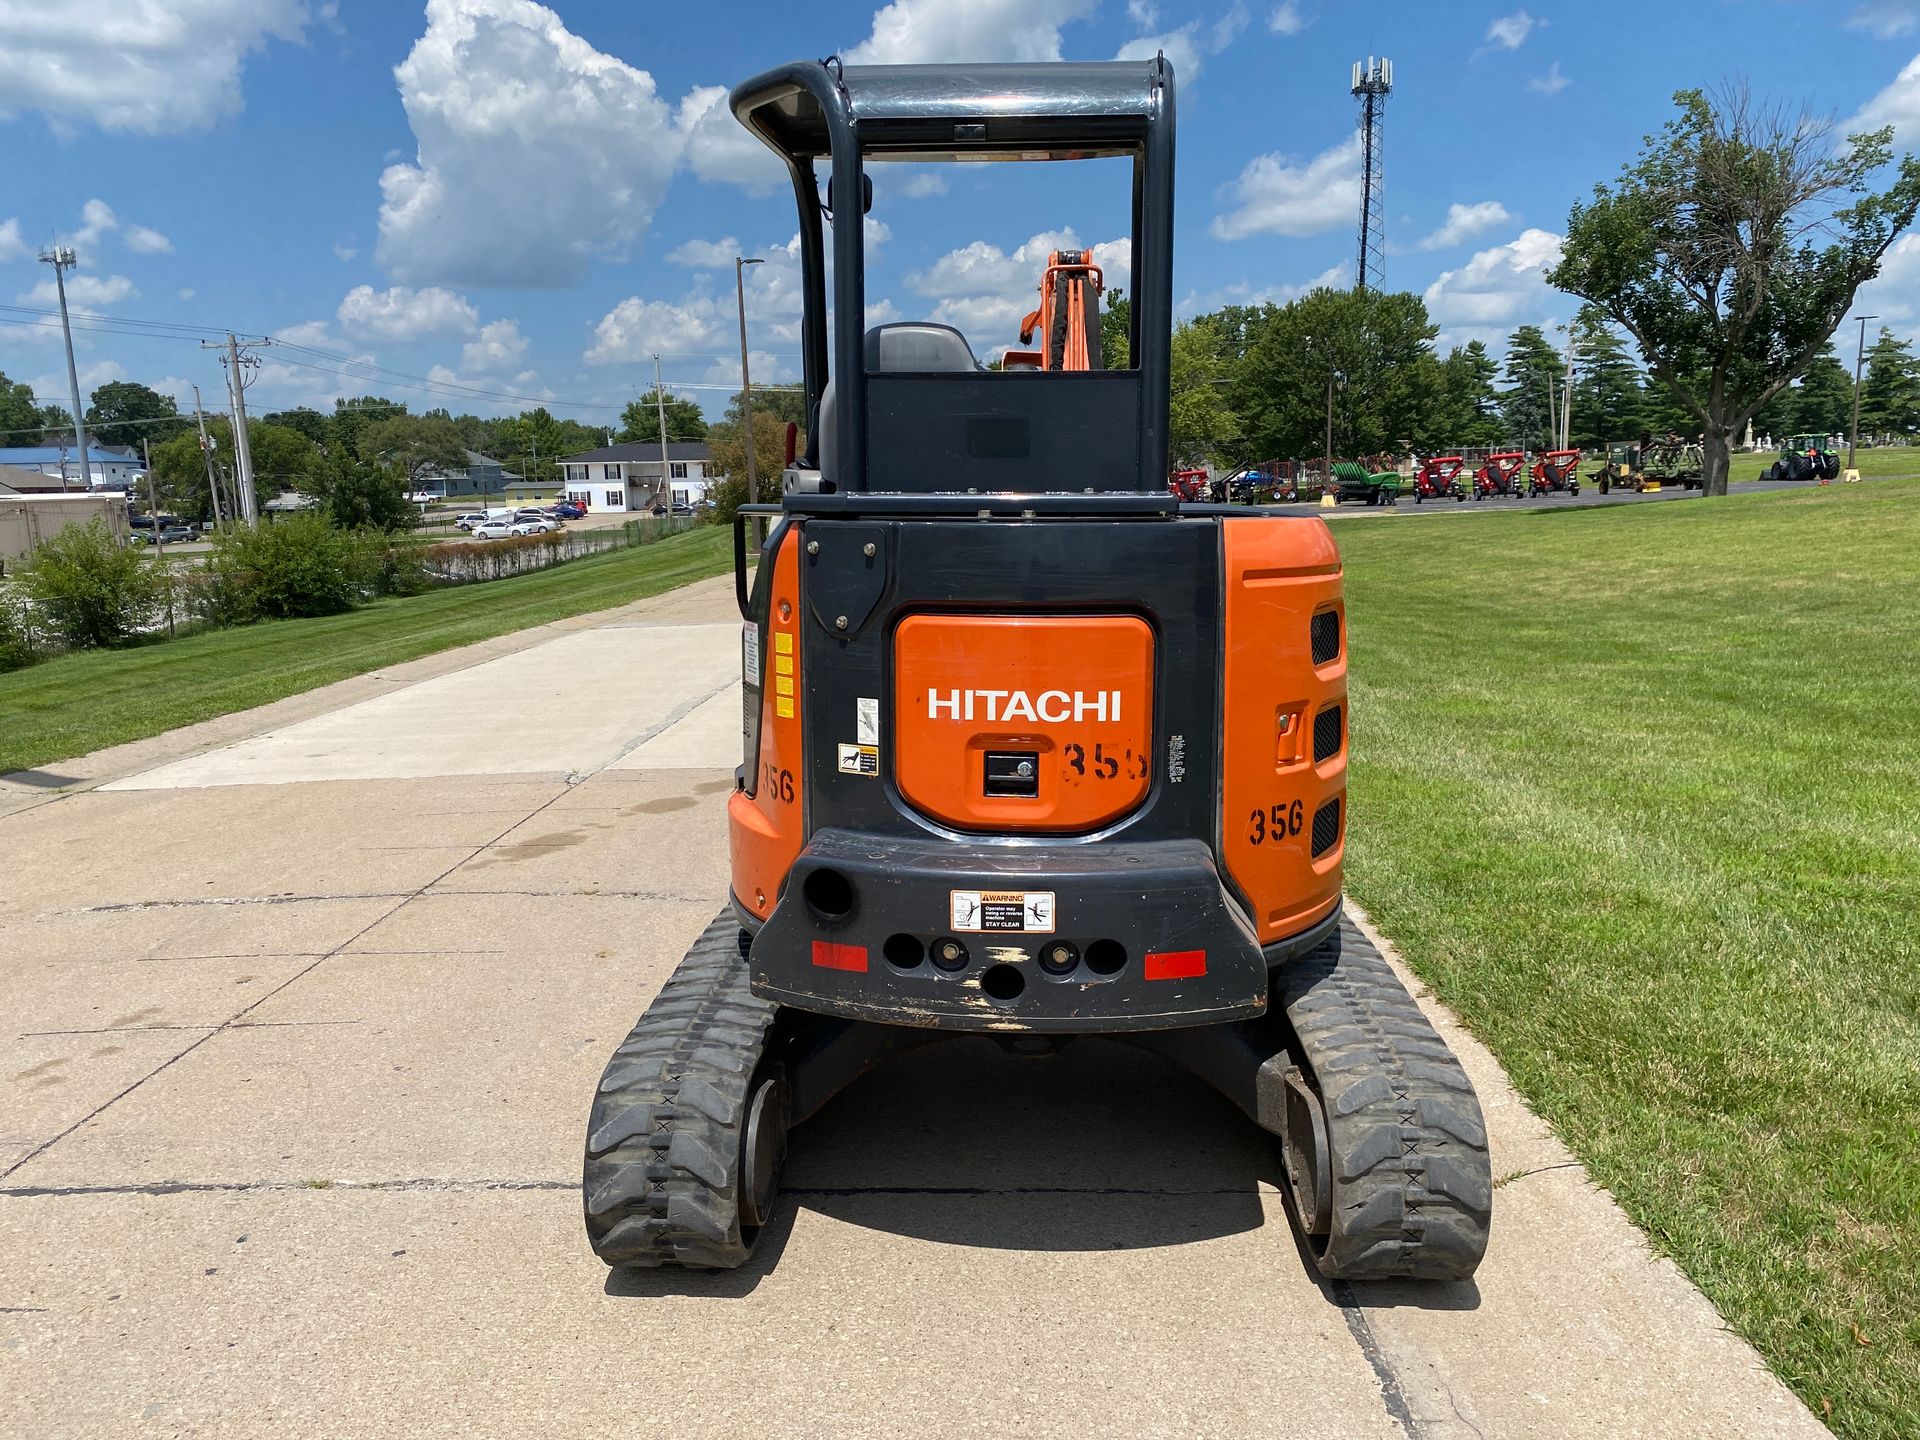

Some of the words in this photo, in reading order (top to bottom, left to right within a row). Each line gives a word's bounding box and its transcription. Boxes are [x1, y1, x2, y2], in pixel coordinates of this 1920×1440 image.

[928, 688, 1121, 723] HITACHI
[1249, 799, 1303, 846] 356
[989, 894, 1023, 902] WARNING
